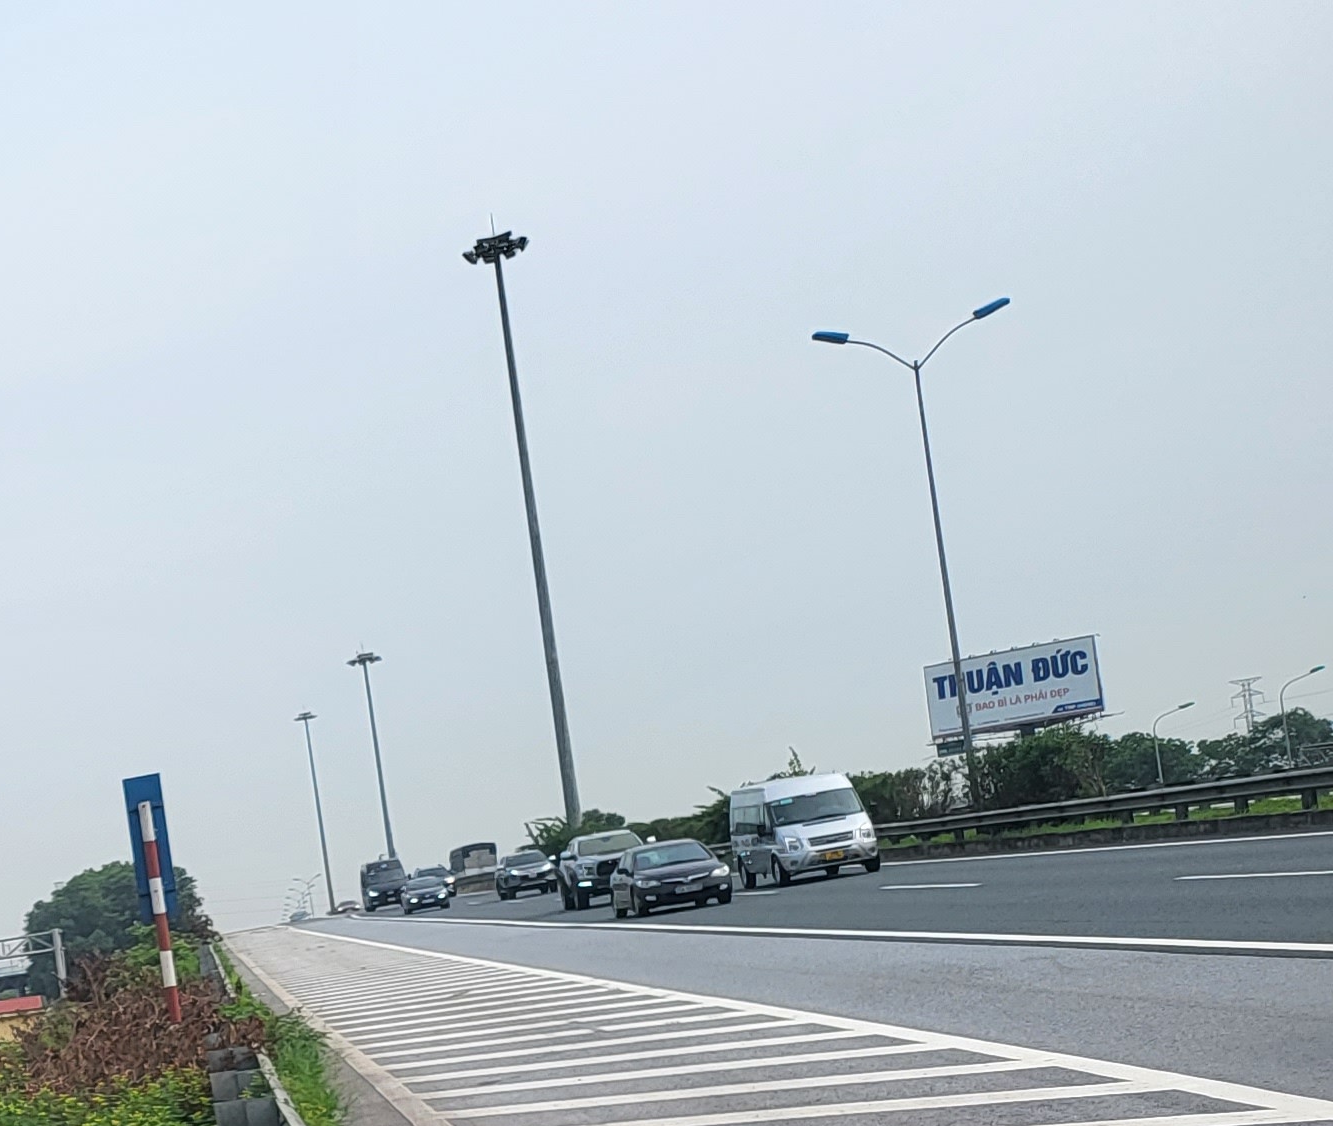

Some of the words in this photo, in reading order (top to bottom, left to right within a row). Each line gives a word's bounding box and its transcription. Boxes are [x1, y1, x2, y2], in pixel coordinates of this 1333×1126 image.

[1031, 649, 1089, 683] ĐỨC
[975, 701, 995, 712] BAO
[997, 696, 1008, 707] BÌ
[1009, 694, 1023, 706] LÀ
[1050, 687, 1070, 701] ĐẸP
